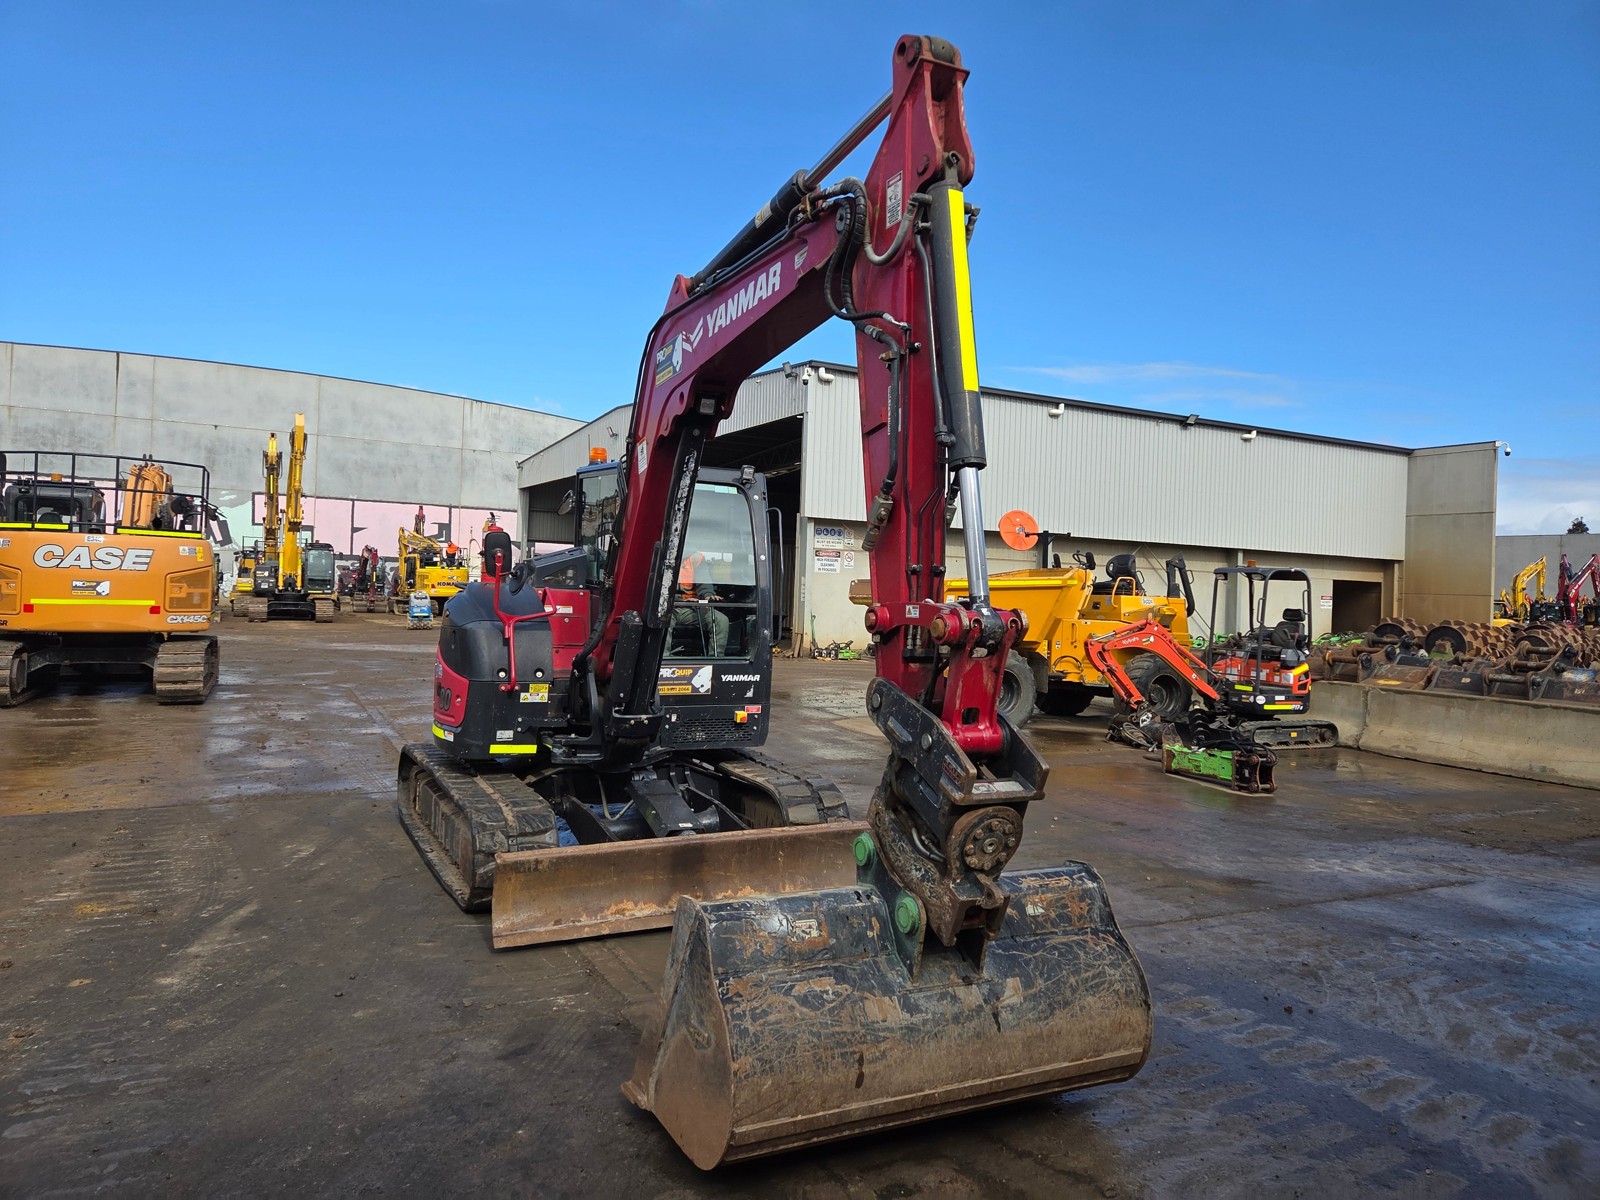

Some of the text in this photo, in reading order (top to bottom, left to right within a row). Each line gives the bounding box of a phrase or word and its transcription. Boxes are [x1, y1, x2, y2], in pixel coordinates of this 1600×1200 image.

[706, 261, 782, 337] YANMAR
[33, 544, 154, 571] CASE
[721, 674, 760, 682] YANMAR
